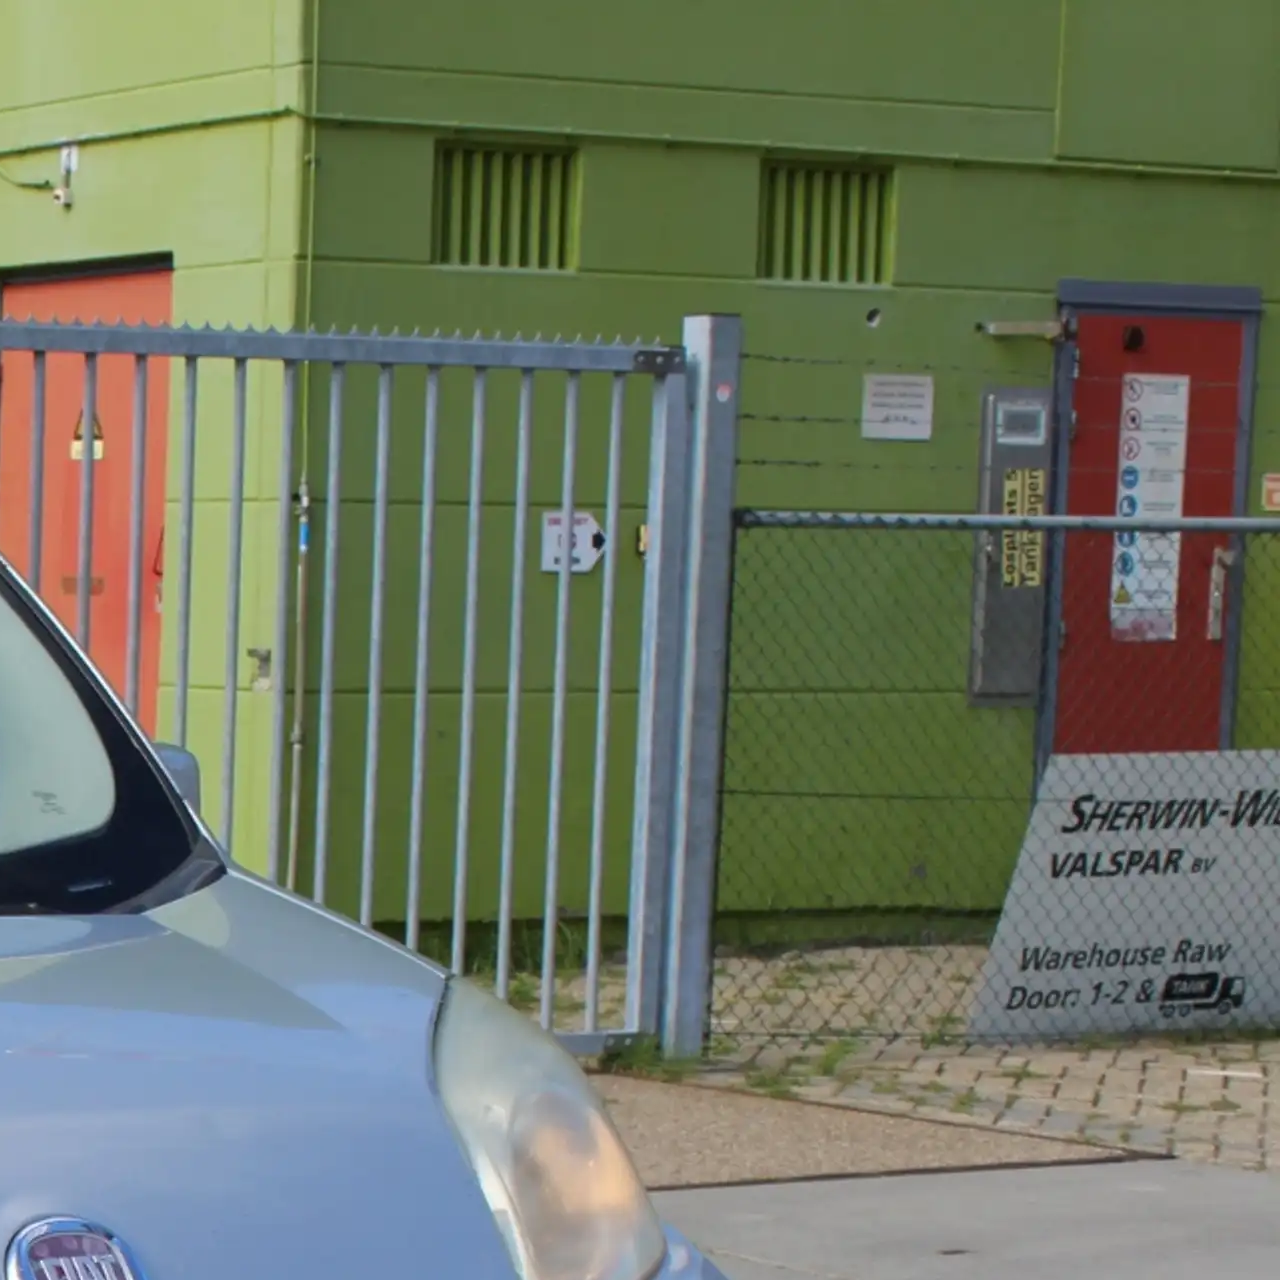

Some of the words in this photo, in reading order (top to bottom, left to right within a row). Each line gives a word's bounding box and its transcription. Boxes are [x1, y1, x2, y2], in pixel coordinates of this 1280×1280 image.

[1023, 468, 1044, 585] Tankagen
[1051, 849, 1184, 878] VALSPAR
[1191, 857, 1216, 873] BV
[1020, 942, 1166, 972] Warehouse
[1172, 939, 1232, 964] Raw
[1090, 980, 1130, 1005] 1-2
[1135, 979, 1154, 1003] &
